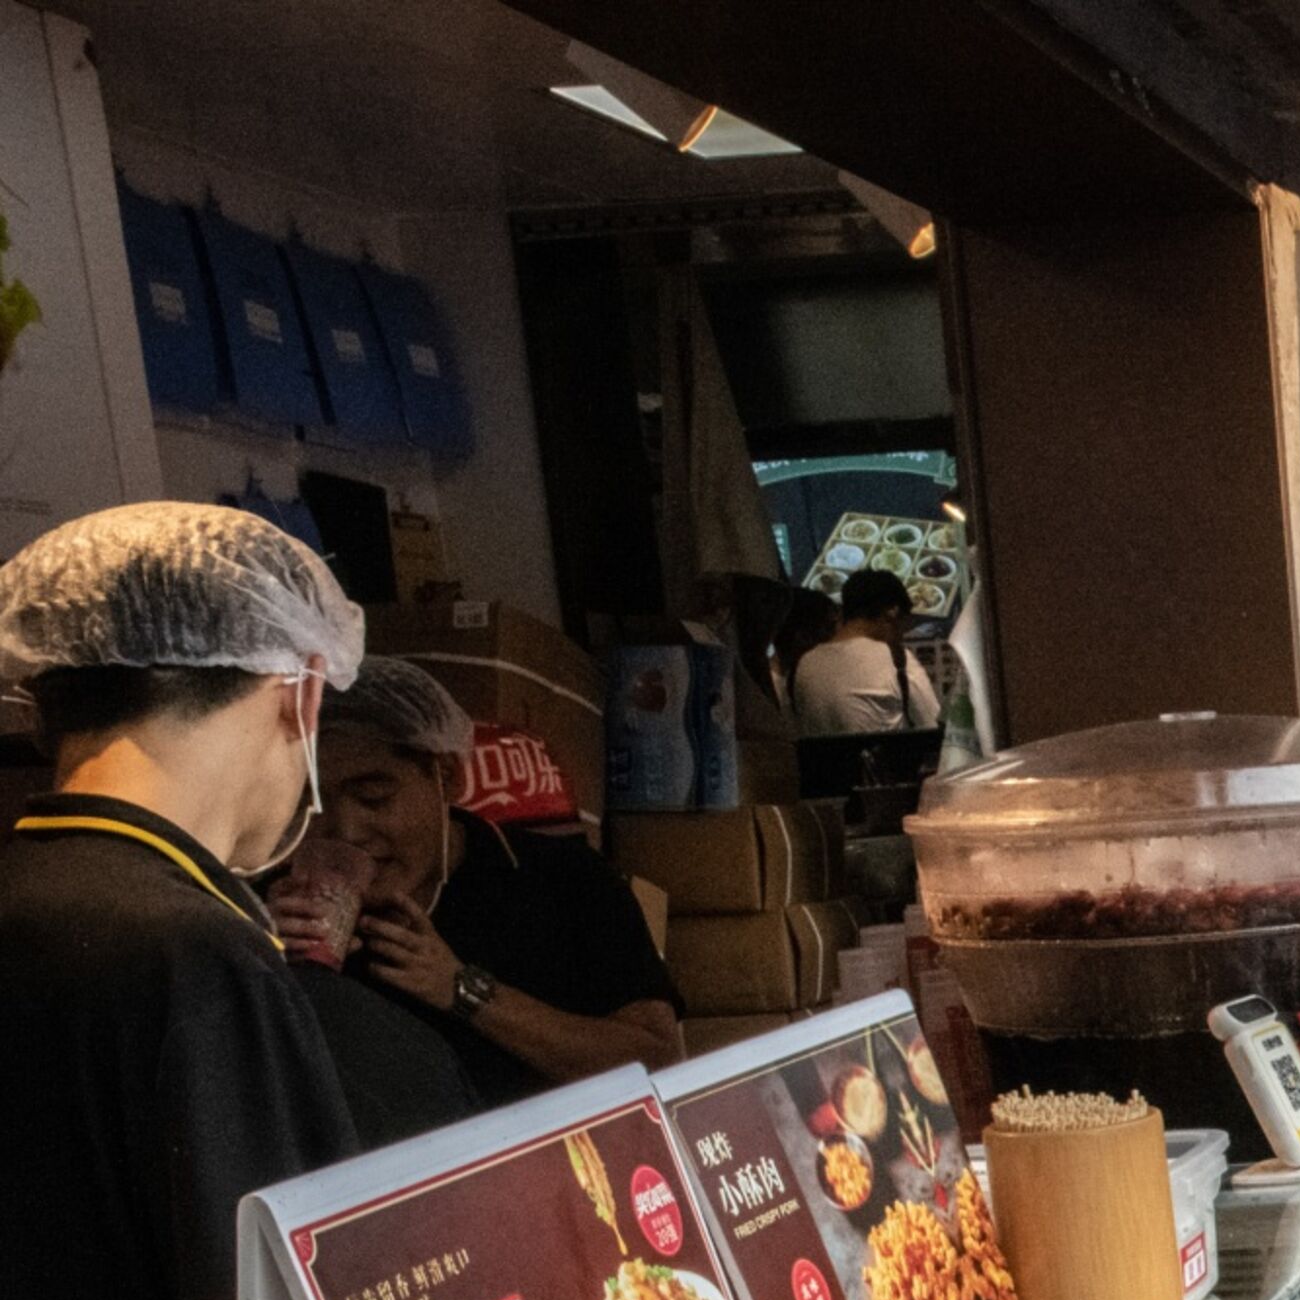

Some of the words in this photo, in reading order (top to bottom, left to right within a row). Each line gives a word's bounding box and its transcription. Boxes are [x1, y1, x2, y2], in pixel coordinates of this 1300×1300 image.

[719, 1156, 785, 1217] 小酥肉
[779, 1198, 800, 1218] PORK
